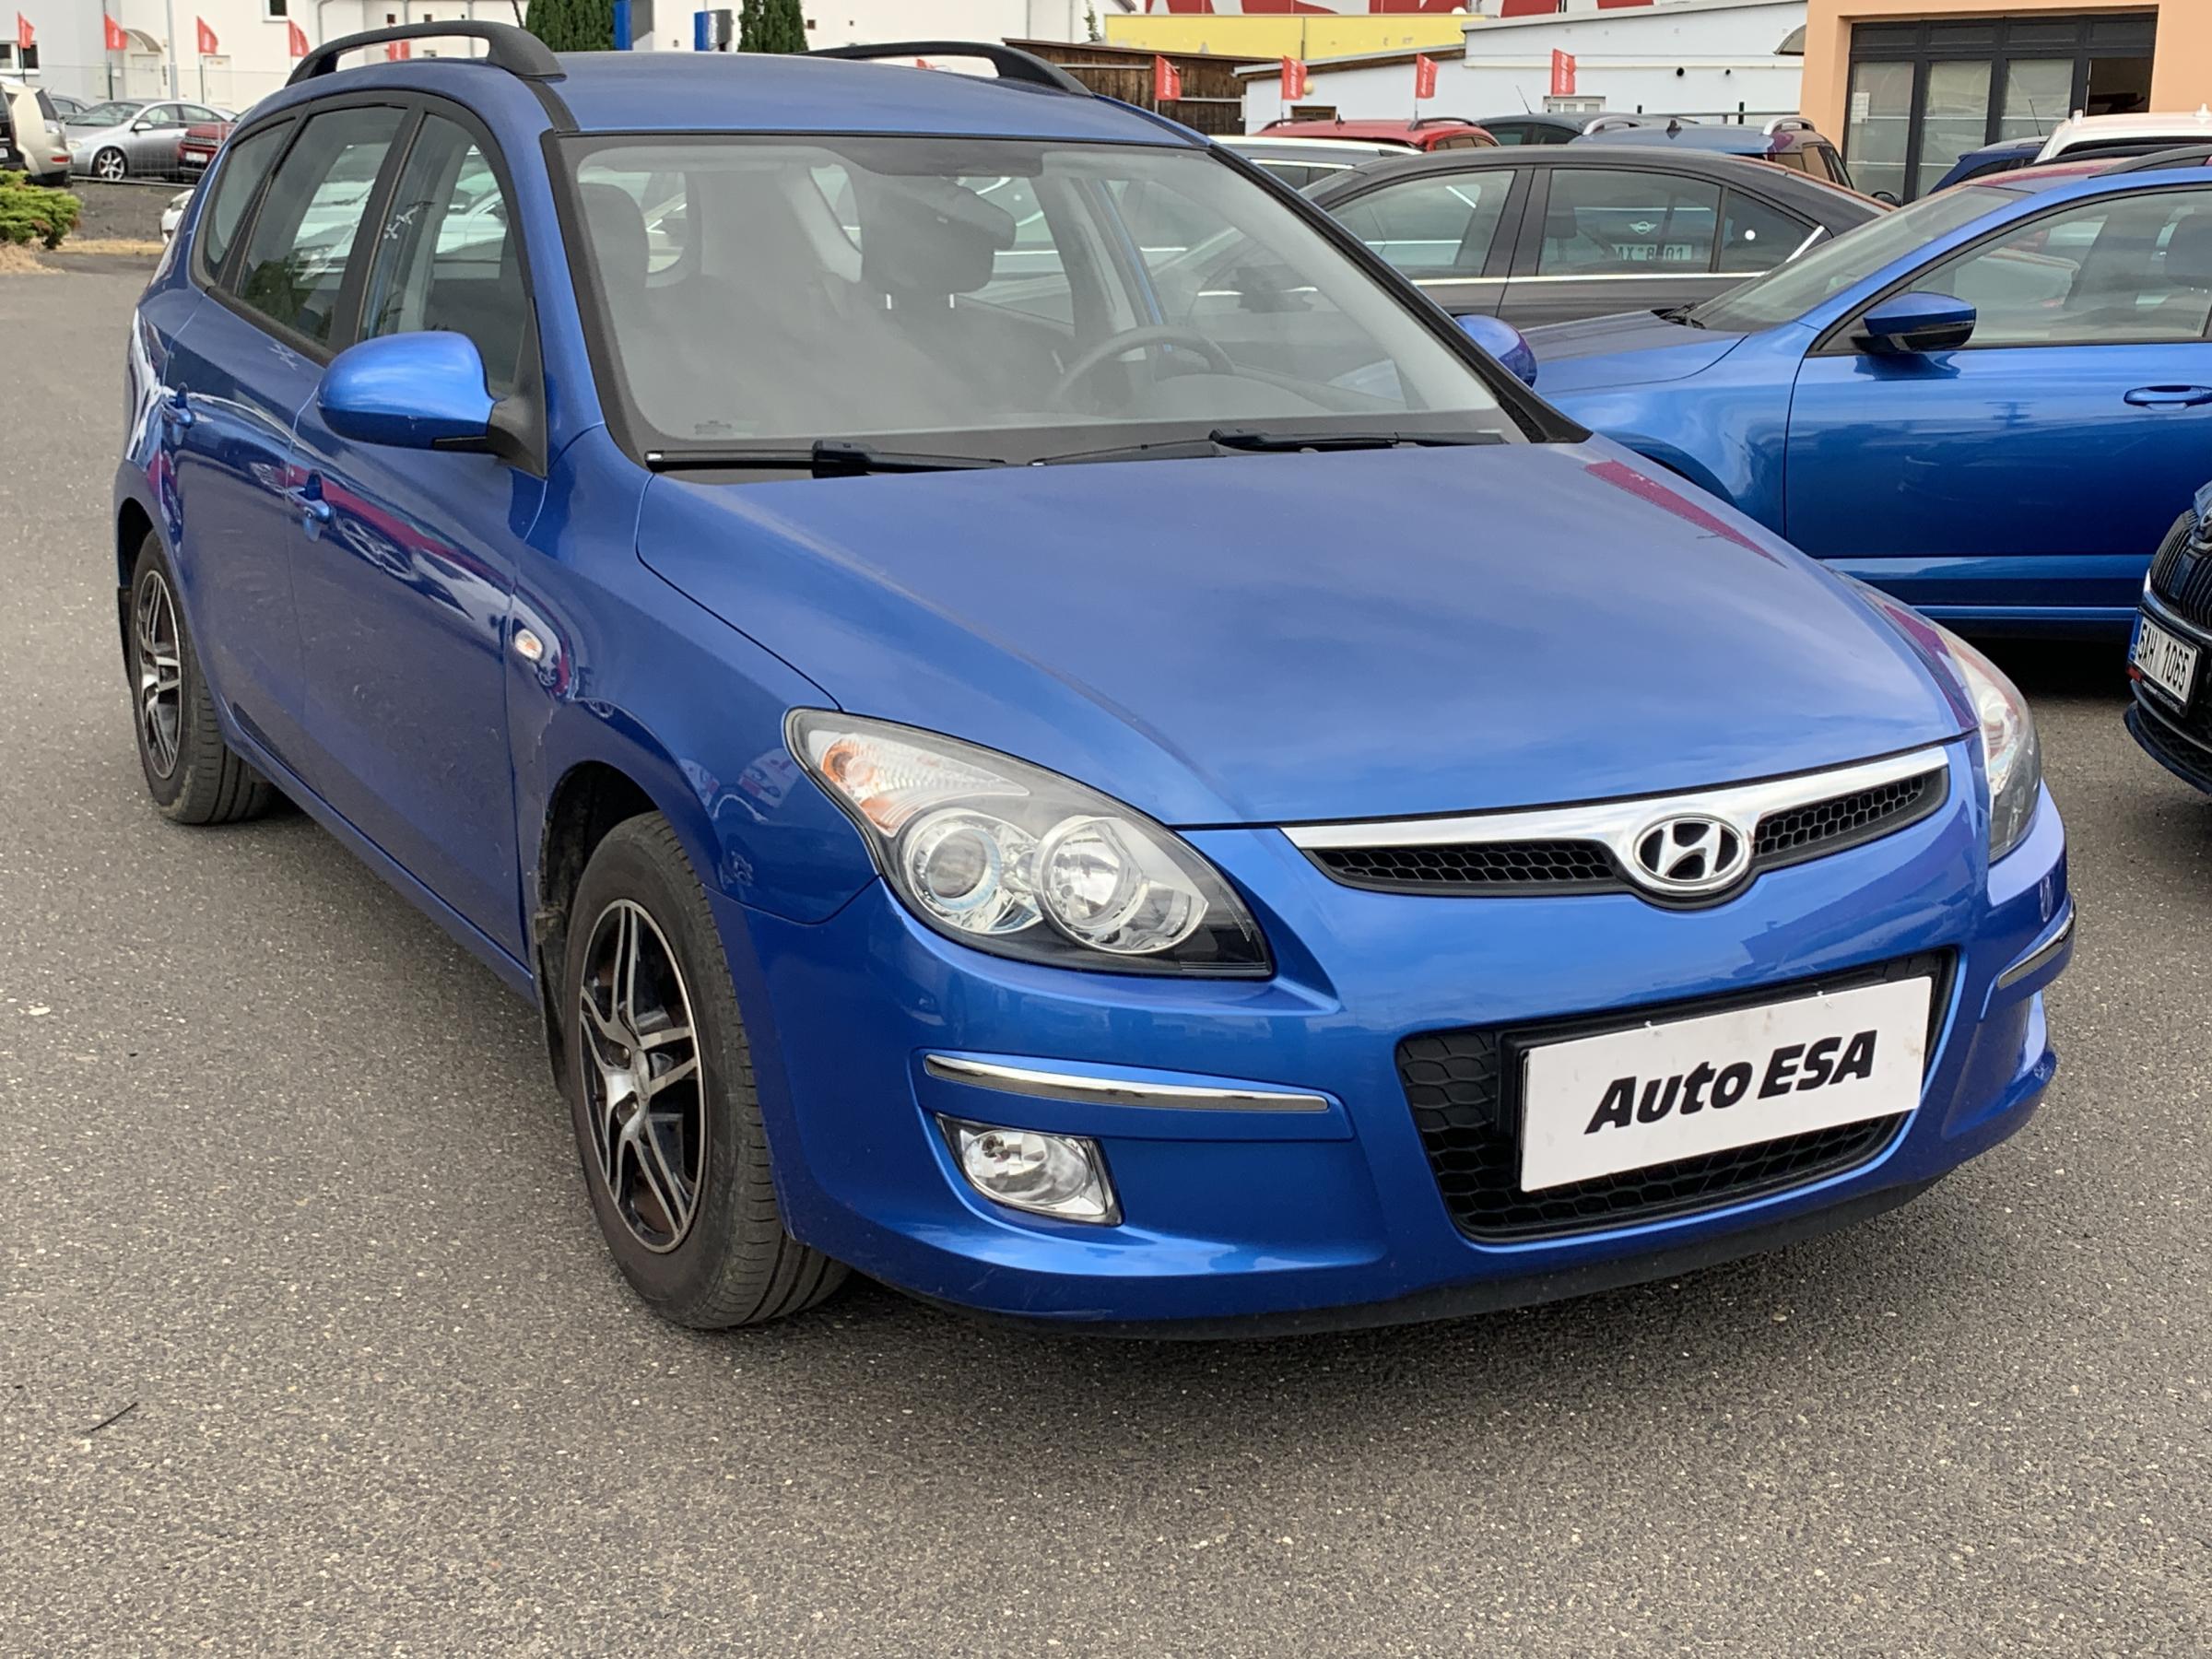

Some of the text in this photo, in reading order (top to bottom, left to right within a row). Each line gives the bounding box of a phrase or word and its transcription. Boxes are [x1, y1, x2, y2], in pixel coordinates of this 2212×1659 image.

[2160, 641, 2190, 693] 1065
[1583, 1030, 1877, 1135] Auto ESA
